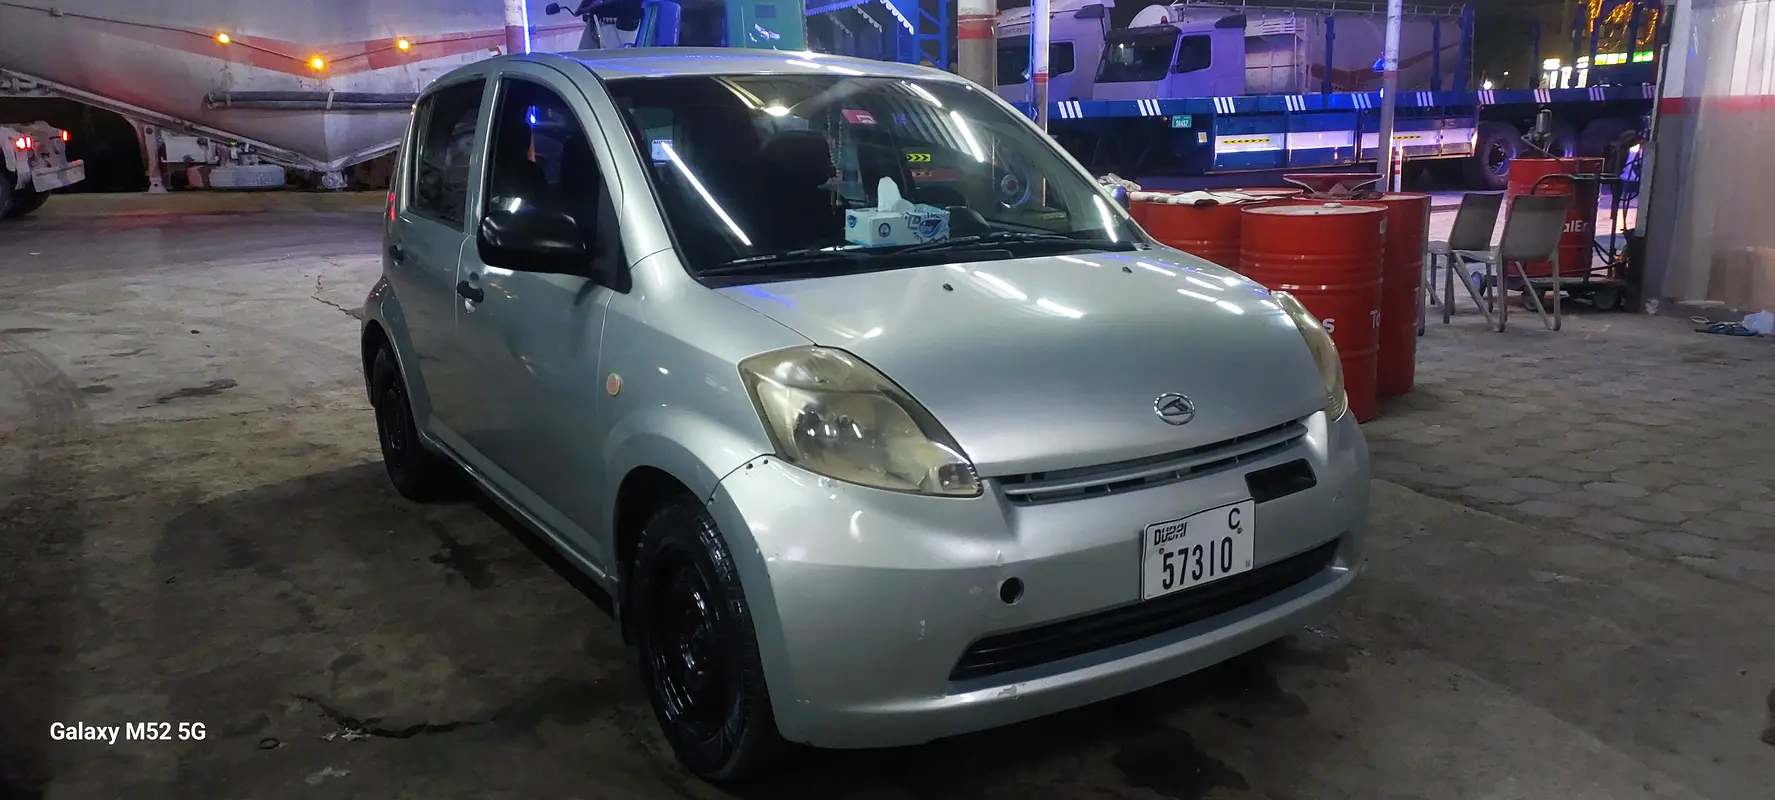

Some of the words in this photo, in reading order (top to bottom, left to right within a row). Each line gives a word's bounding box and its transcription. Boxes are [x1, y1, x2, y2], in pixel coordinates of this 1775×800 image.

[1153, 521, 1188, 546] DUBAI
[1228, 507, 1241, 530] C
[1162, 536, 1233, 590] 57310
